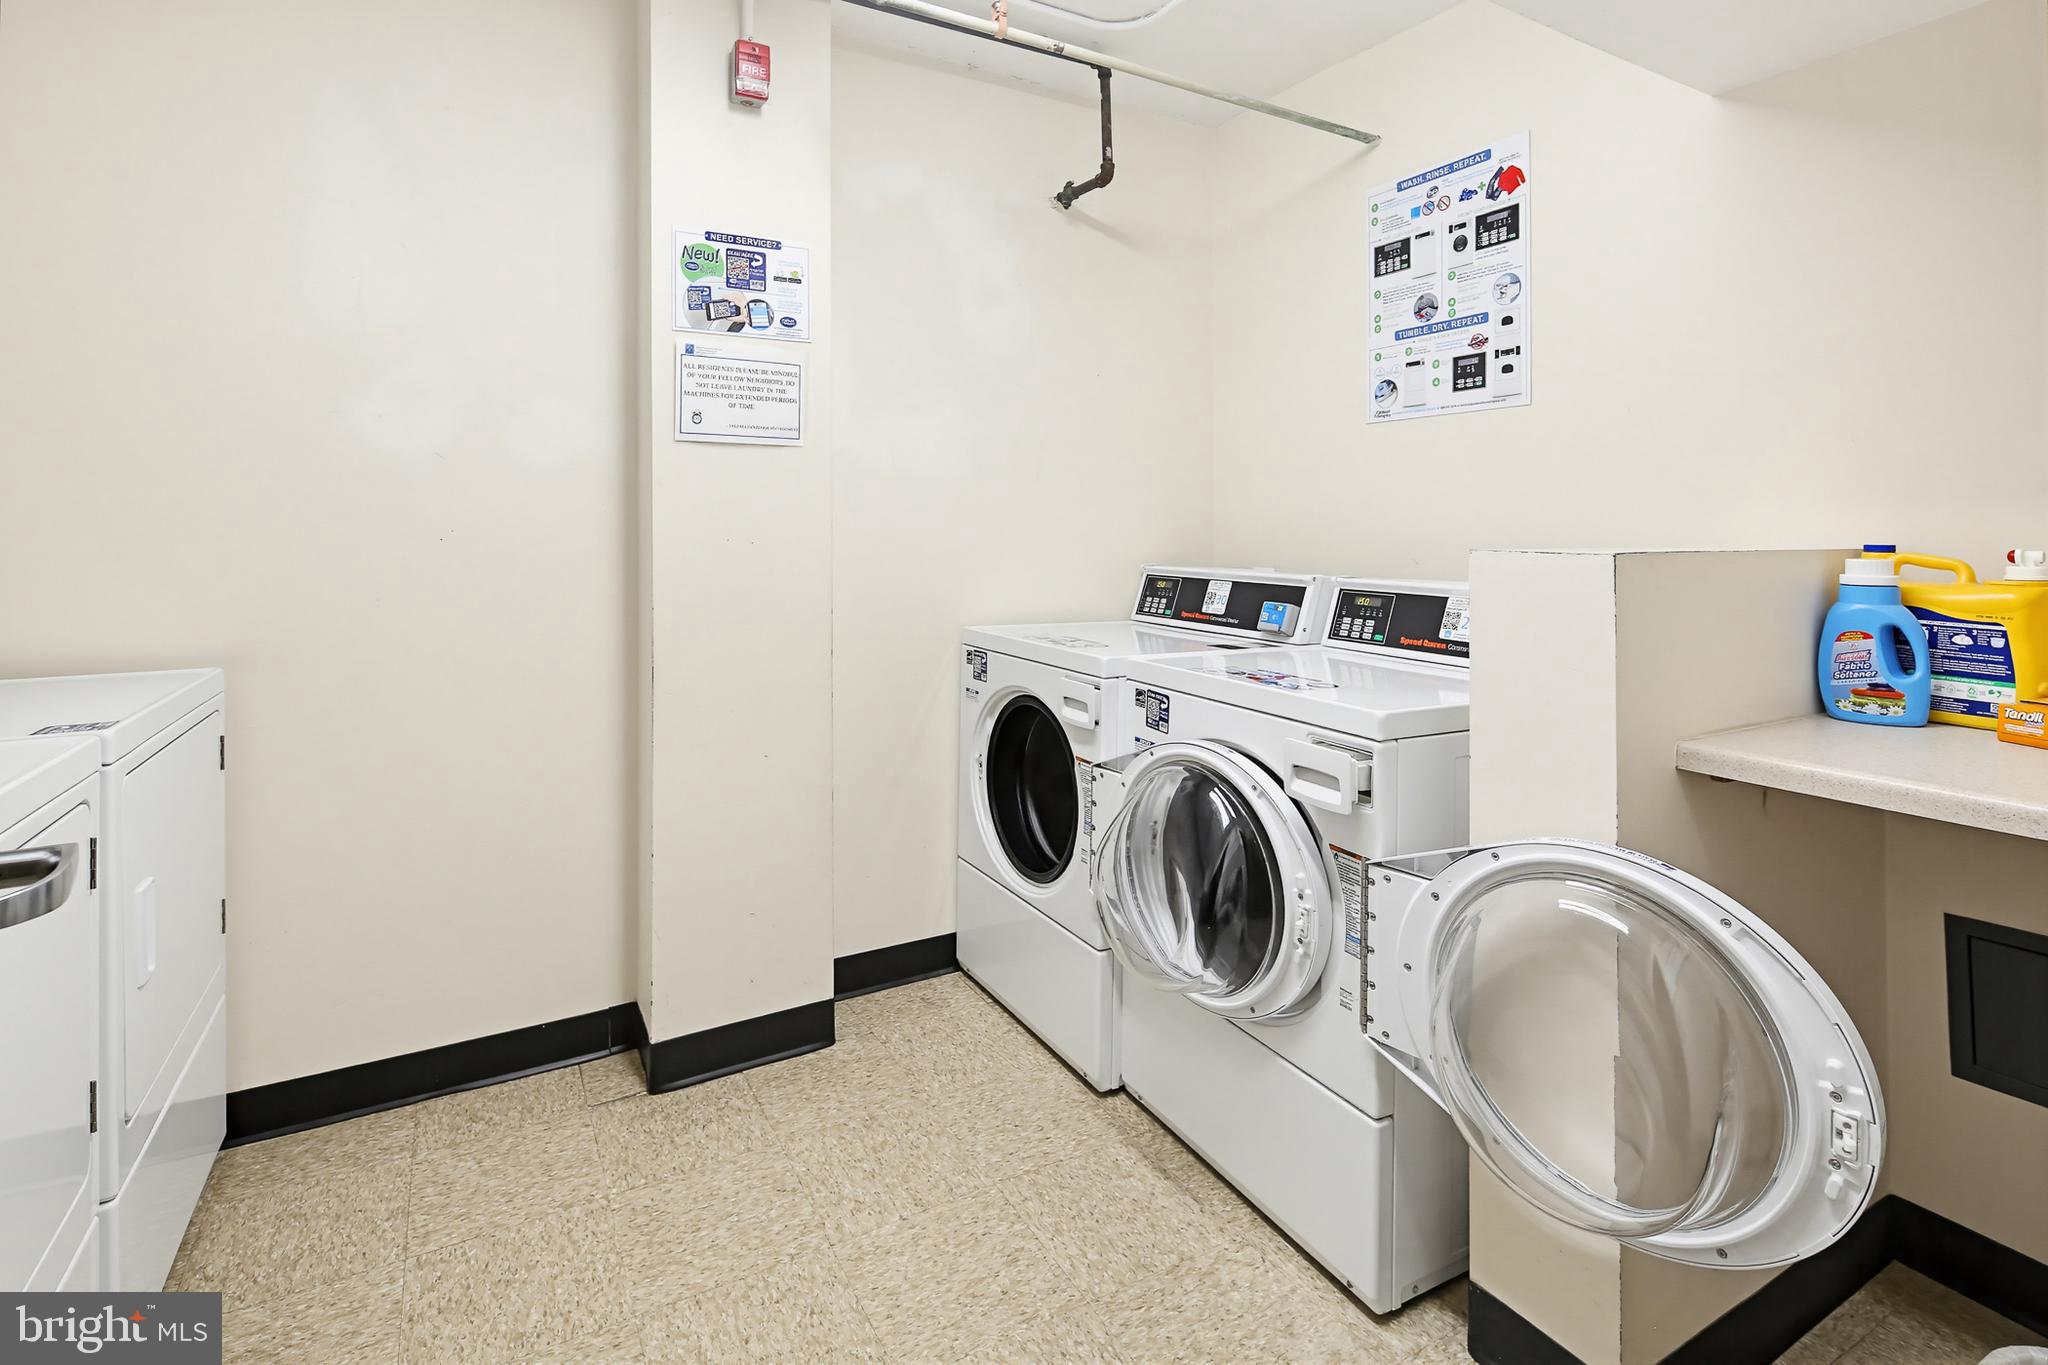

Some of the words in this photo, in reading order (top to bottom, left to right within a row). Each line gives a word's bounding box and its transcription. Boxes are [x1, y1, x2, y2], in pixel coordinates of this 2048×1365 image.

[742, 64, 767, 79] FIRE
[1400, 176, 1425, 189] WASH.
[1426, 166, 1452, 181] RINSE.
[1453, 153, 1486, 171] REPEAT.
[710, 232, 734, 243] NEED
[735, 236, 777, 249] SERVICE?
[682, 245, 720, 264] New!
[1399, 326, 1431, 339] TUMBLE.
[1432, 322, 1450, 332] DRY.
[1451, 314, 1485, 328] REPEAT.
[698, 364, 734, 372] RESIDENTS
[719, 374, 746, 382] FELLOW
[734, 385, 766, 393] LAUNDRY
[684, 390, 720, 398] MACHINES
[736, 394, 771, 402] EXTENDED
[1400, 636, 1423, 647] Speed
[1423, 639, 1447, 650] Queen
[1840, 661, 1871, 671] Fabric
[1834, 670, 1876, 680] Softener
